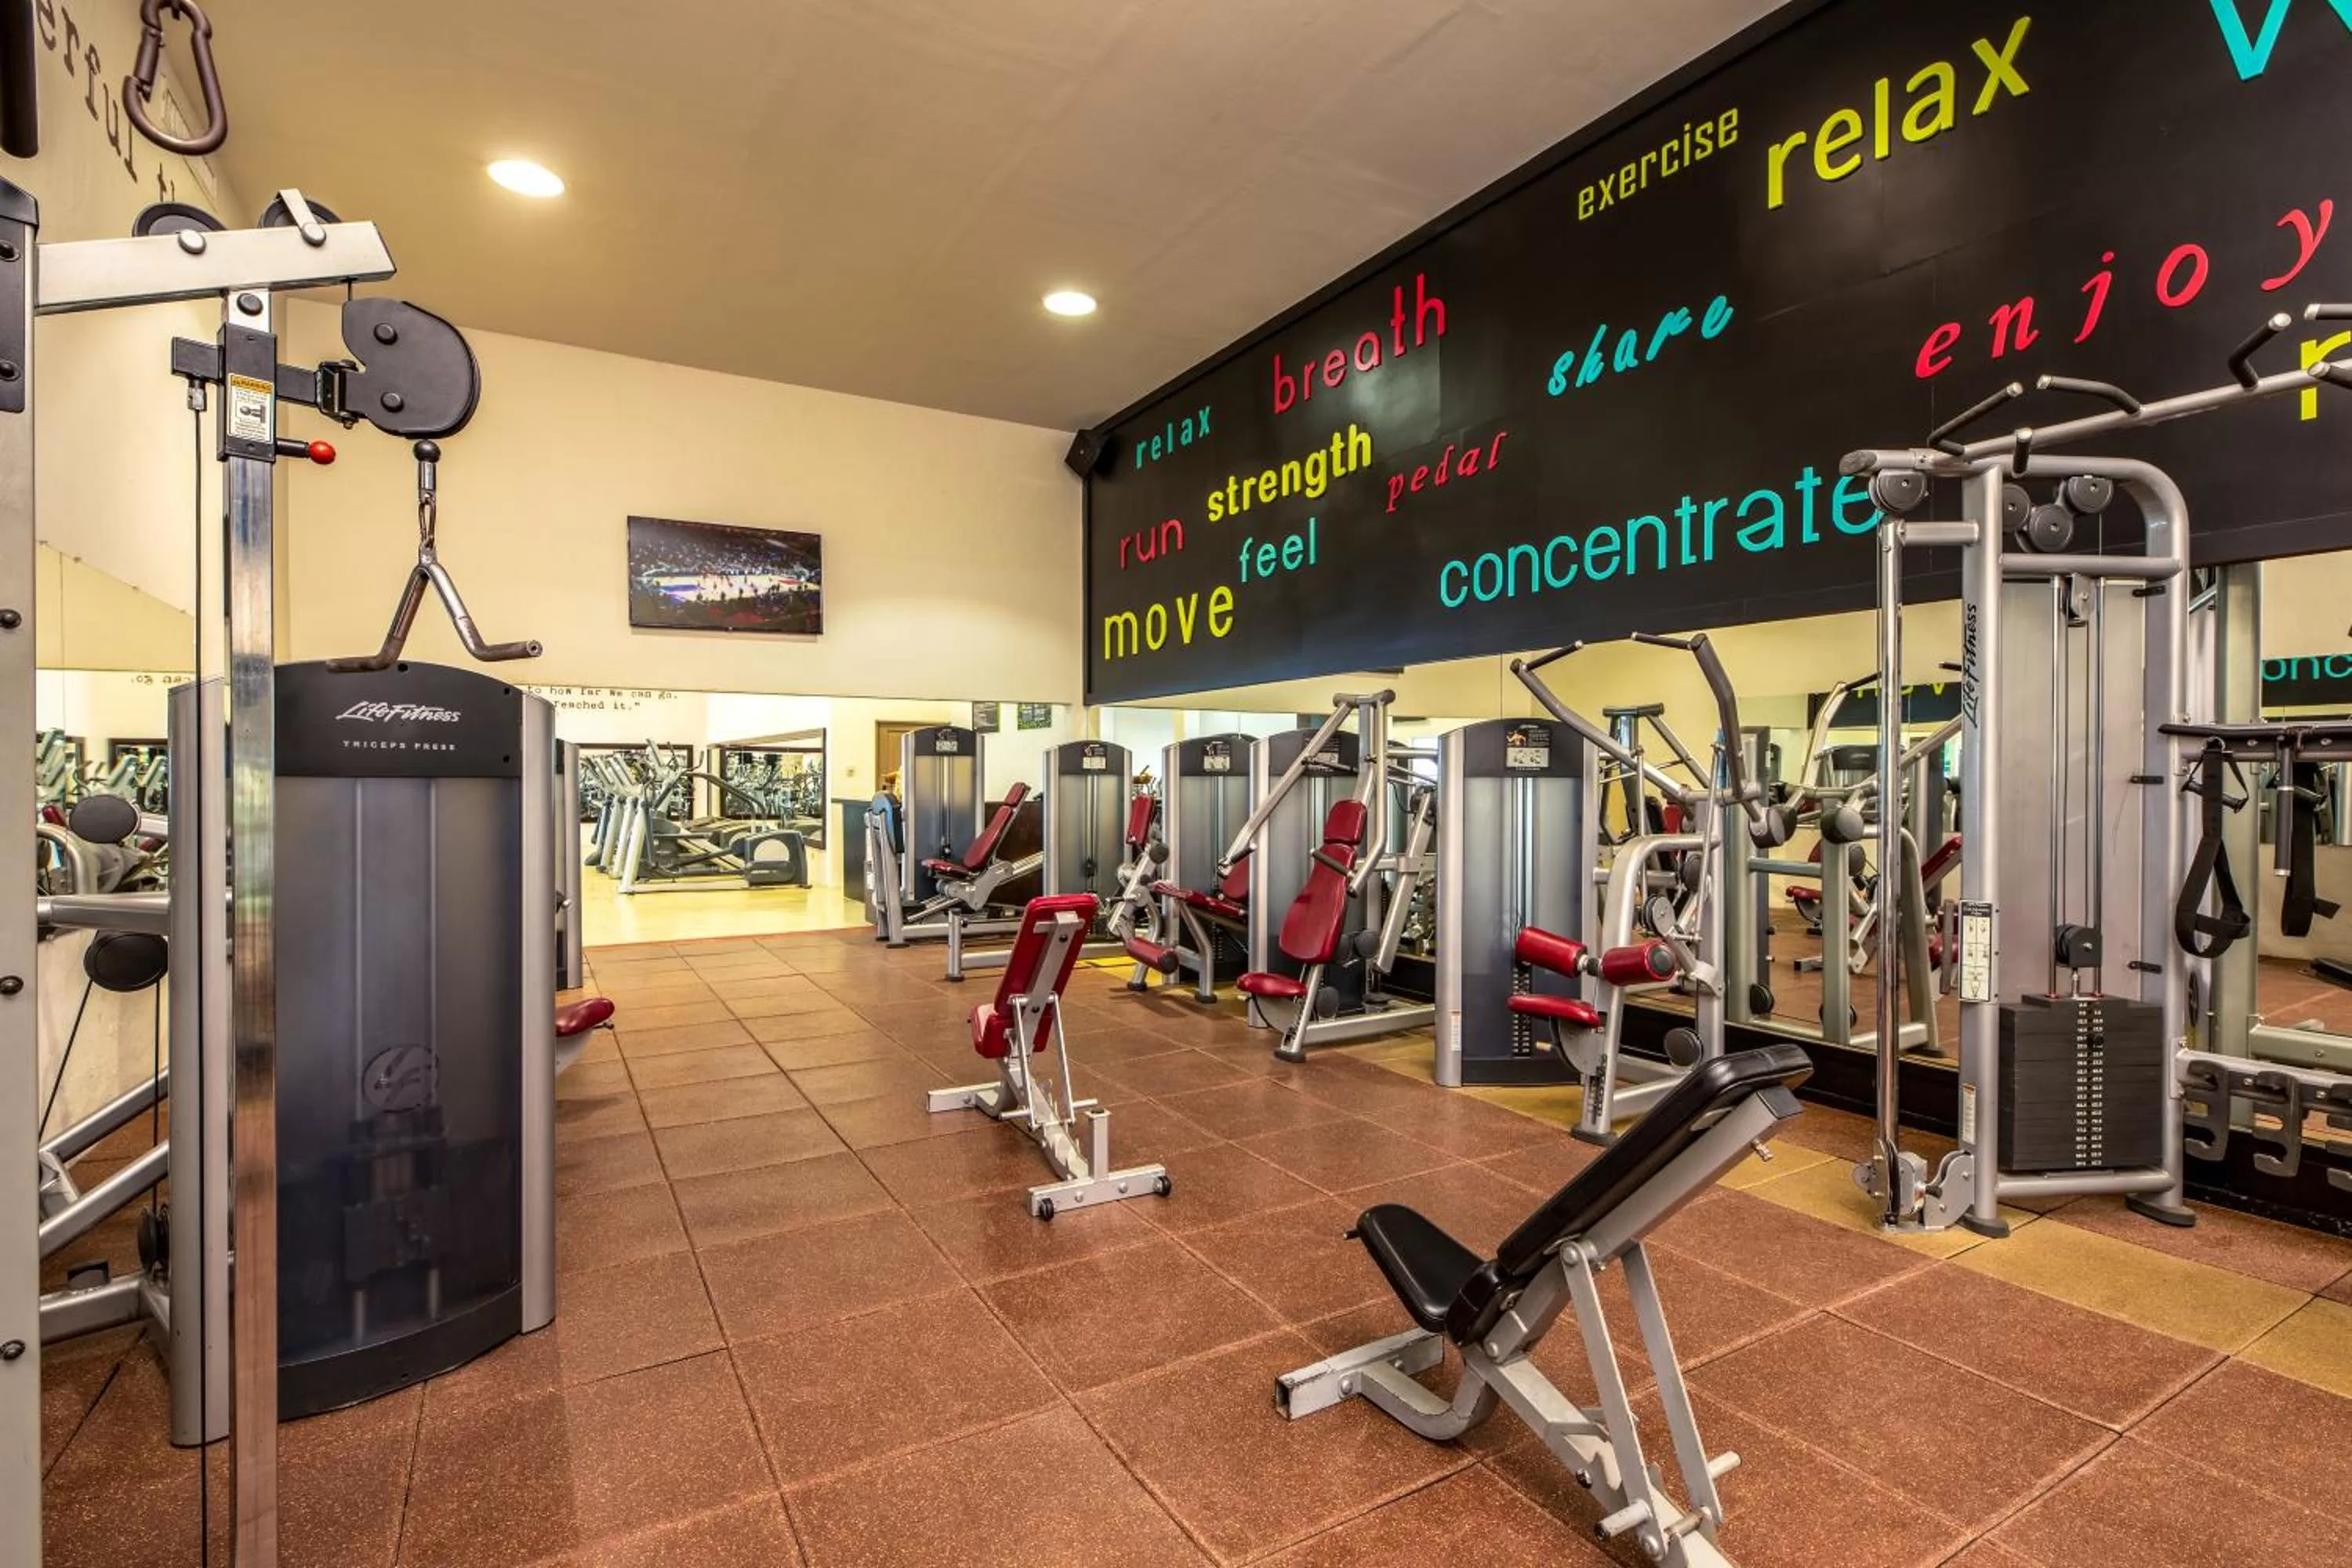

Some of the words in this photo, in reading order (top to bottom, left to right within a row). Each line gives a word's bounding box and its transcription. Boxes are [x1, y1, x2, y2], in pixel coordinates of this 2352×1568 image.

[1767, 16, 2031, 209] relax
[1578, 107, 1739, 220] exercise
[1914, 198, 2333, 379] enjoy
[1273, 272, 1446, 415] breath
[1547, 295, 1733, 397] share
[1135, 406, 1212, 470] relax
[1207, 423, 1373, 522] strength
[1385, 430, 1508, 514] pedal
[1120, 517, 1185, 569] run
[1240, 517, 1317, 583] feel
[1439, 466, 1885, 608] concentrate
[1104, 584, 1234, 660] move
[550, 686, 572, 695] how
[580, 688, 602, 696] far
[609, 689, 623, 698] we
[554, 700, 605, 710] reached
[343, 740, 406, 749] TRICEPS
